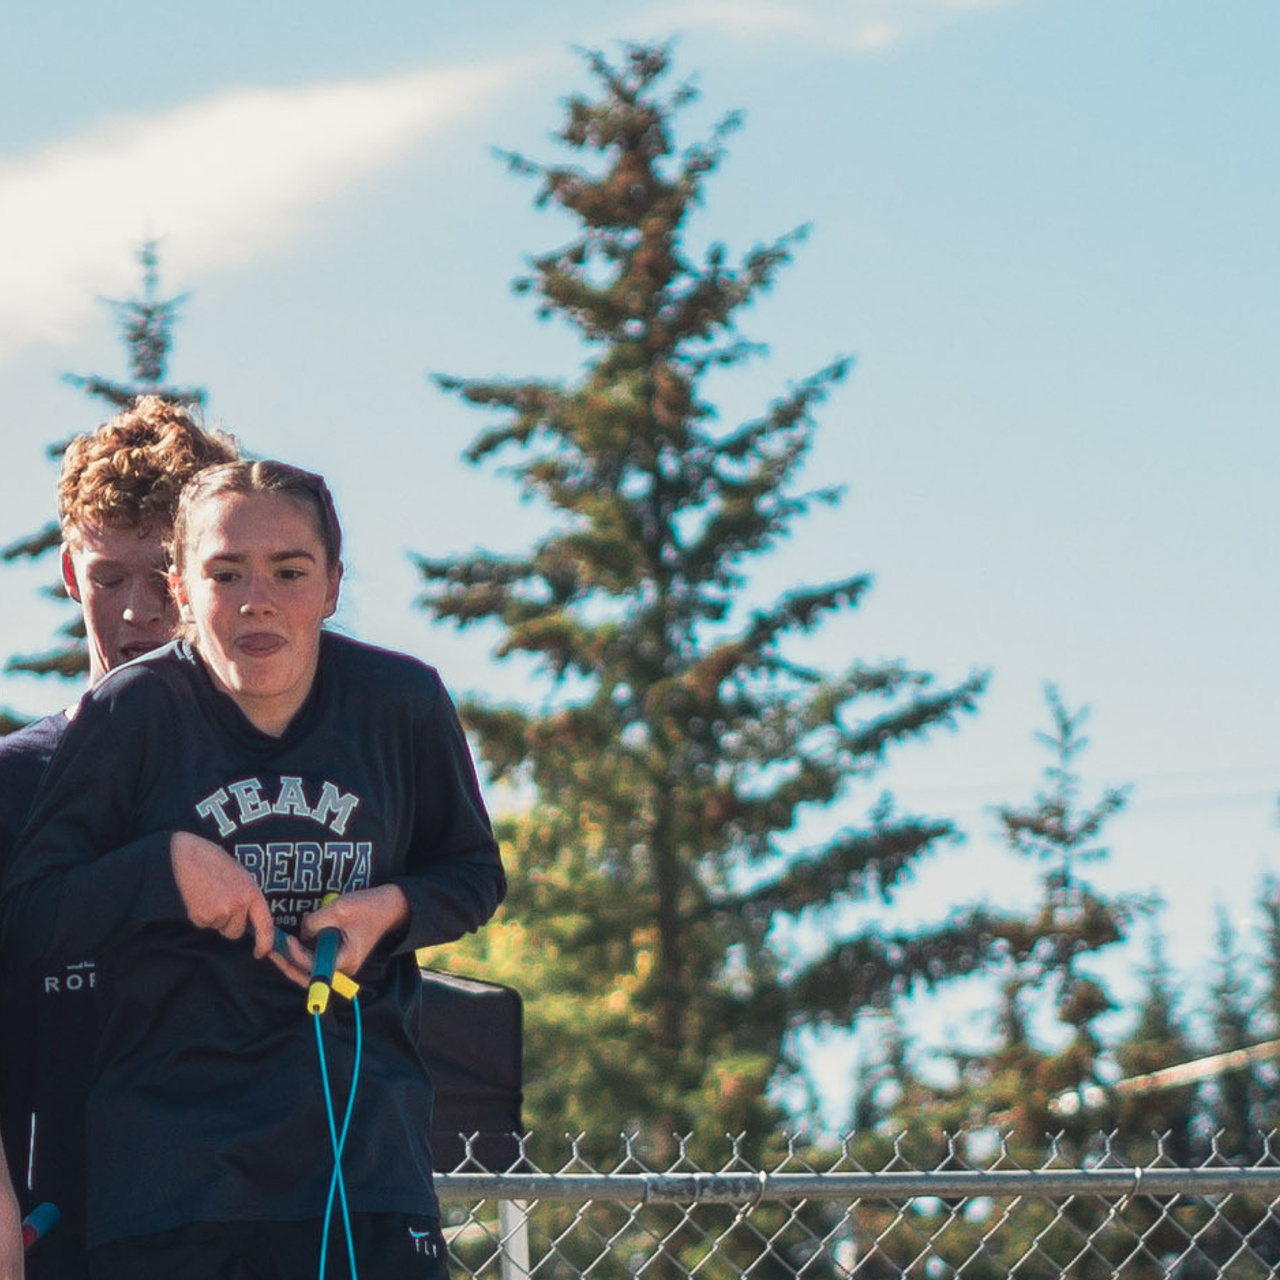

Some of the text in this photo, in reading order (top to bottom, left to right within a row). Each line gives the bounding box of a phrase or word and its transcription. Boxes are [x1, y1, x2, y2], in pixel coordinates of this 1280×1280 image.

[195, 775, 360, 838] TEAM
[234, 841, 373, 894] BERTA
[270, 898, 322, 912] KIP
